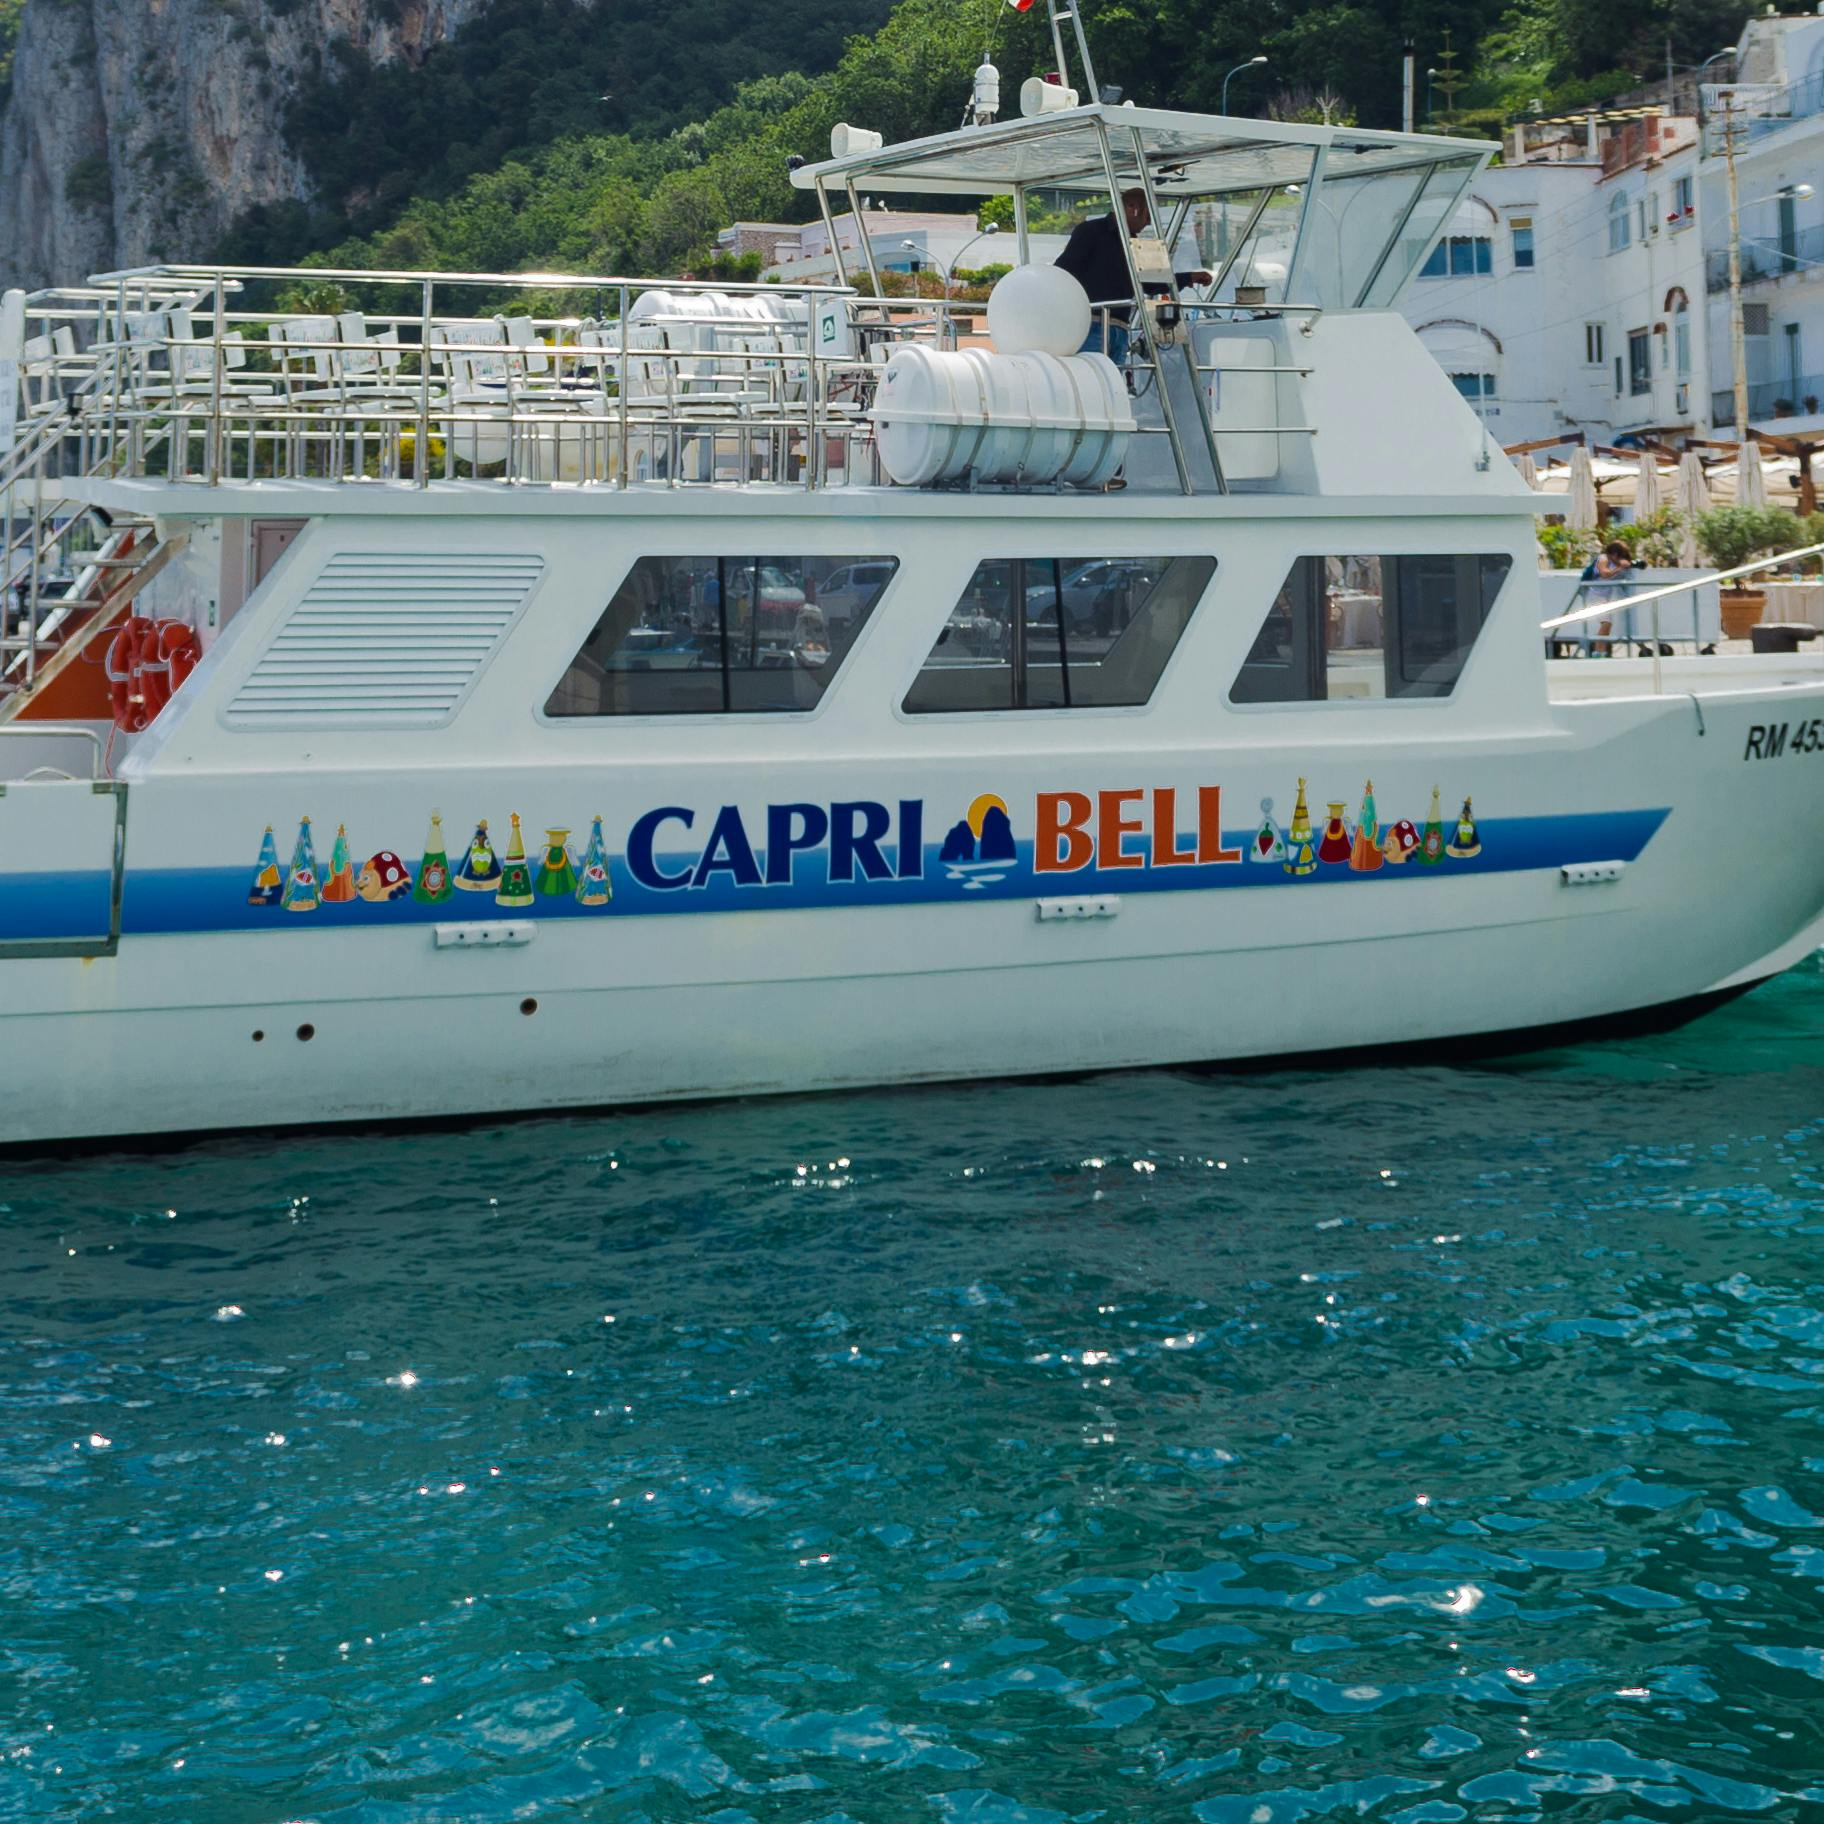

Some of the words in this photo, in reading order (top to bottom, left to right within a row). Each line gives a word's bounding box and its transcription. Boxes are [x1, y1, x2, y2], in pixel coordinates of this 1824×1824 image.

[1744, 723, 1789, 761] RM
[626, 799, 924, 892] CAPRI
[1033, 785, 1243, 874] BELL
